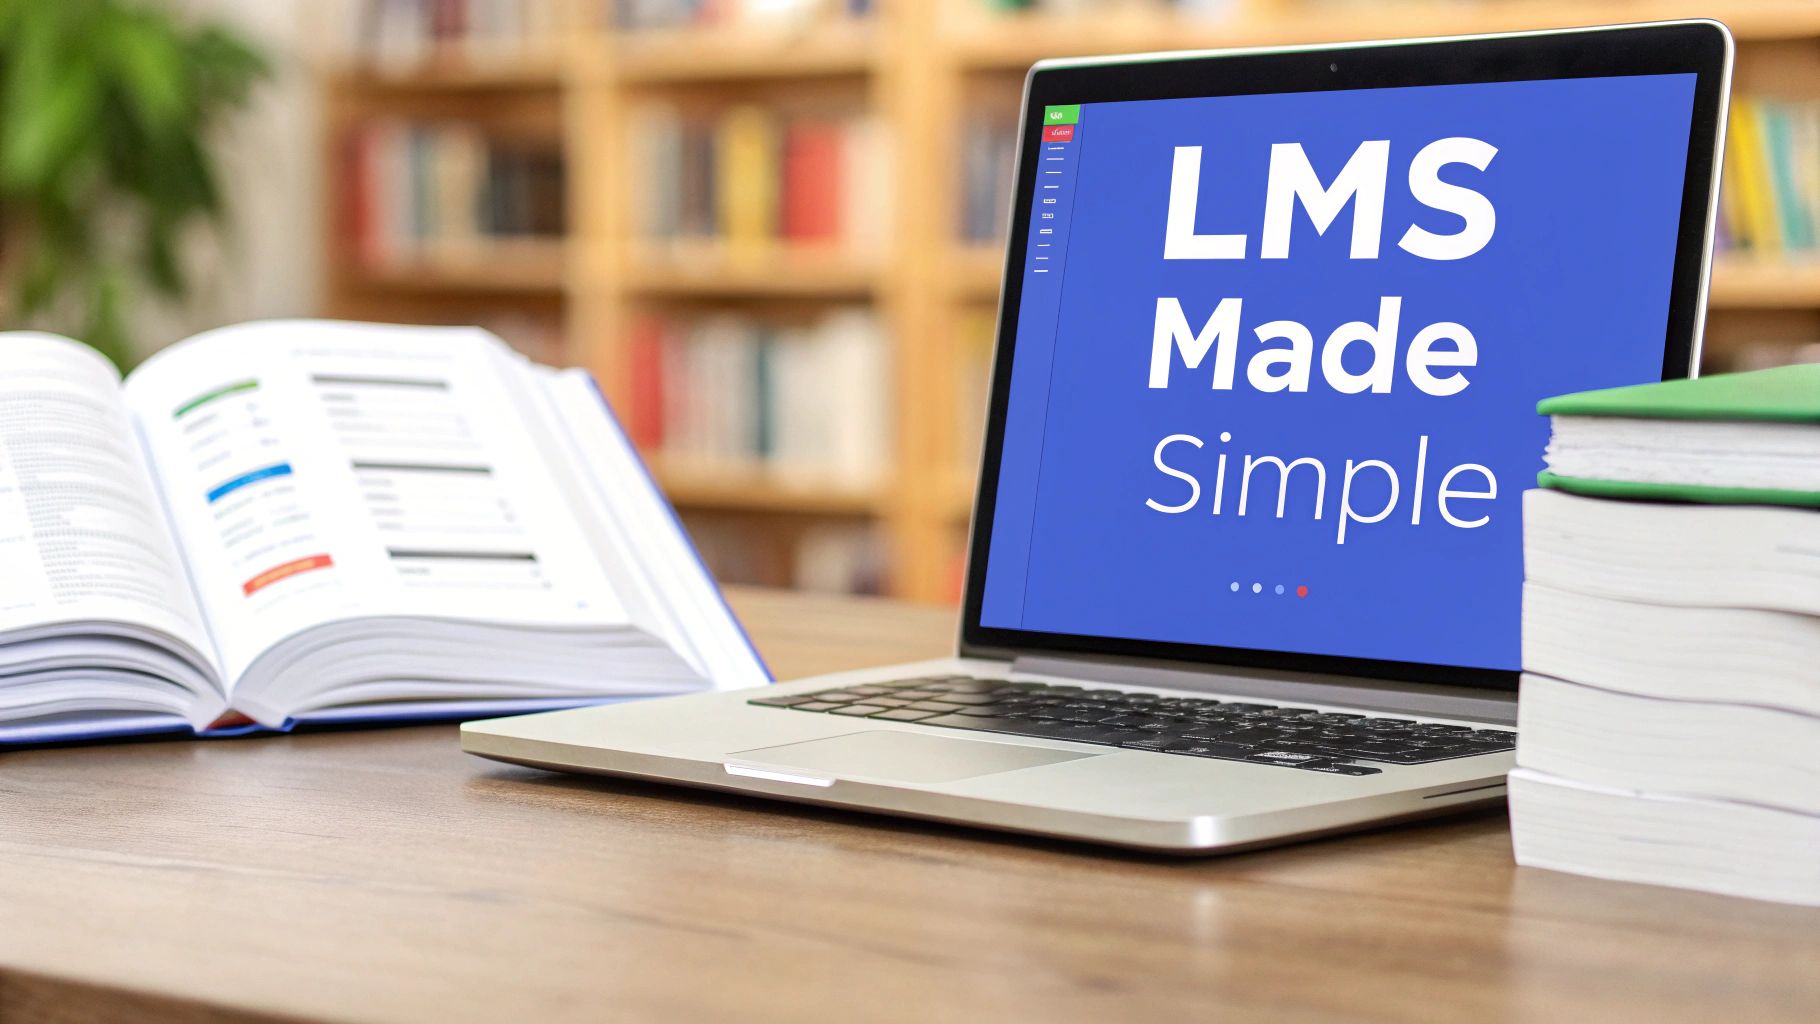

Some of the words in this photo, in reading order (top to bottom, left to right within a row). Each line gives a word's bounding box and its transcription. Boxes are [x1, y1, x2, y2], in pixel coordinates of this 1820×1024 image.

[1163, 136, 1499, 261] LMS
[1148, 296, 1478, 397] Made
[1145, 431, 1498, 545] Simple
